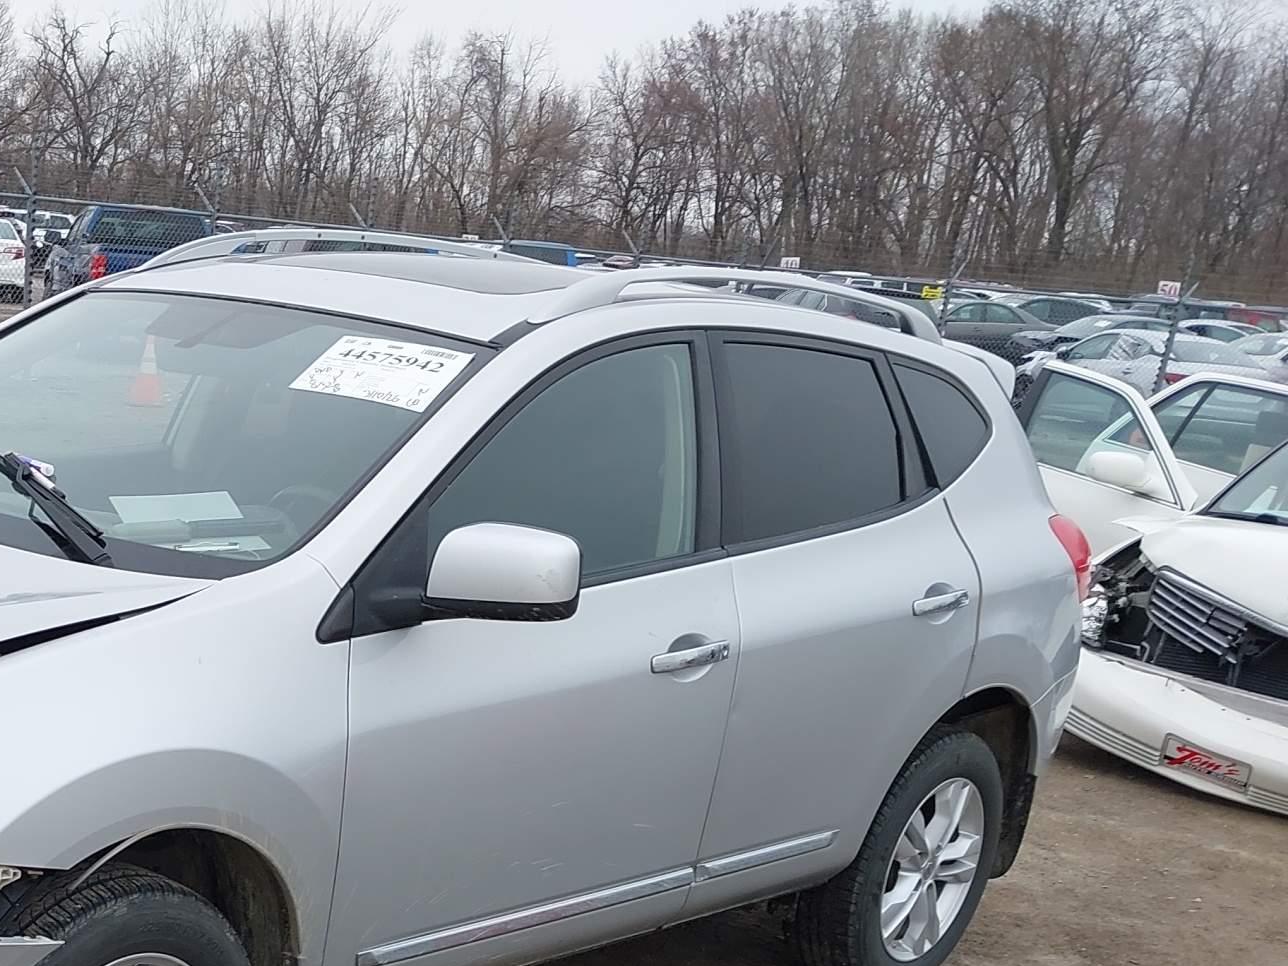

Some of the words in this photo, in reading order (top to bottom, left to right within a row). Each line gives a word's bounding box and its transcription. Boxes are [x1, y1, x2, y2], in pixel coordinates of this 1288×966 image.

[1159, 283, 1178, 297] 50
[339, 348, 445, 373] 44575942
[1166, 745, 1241, 777] Tom's
